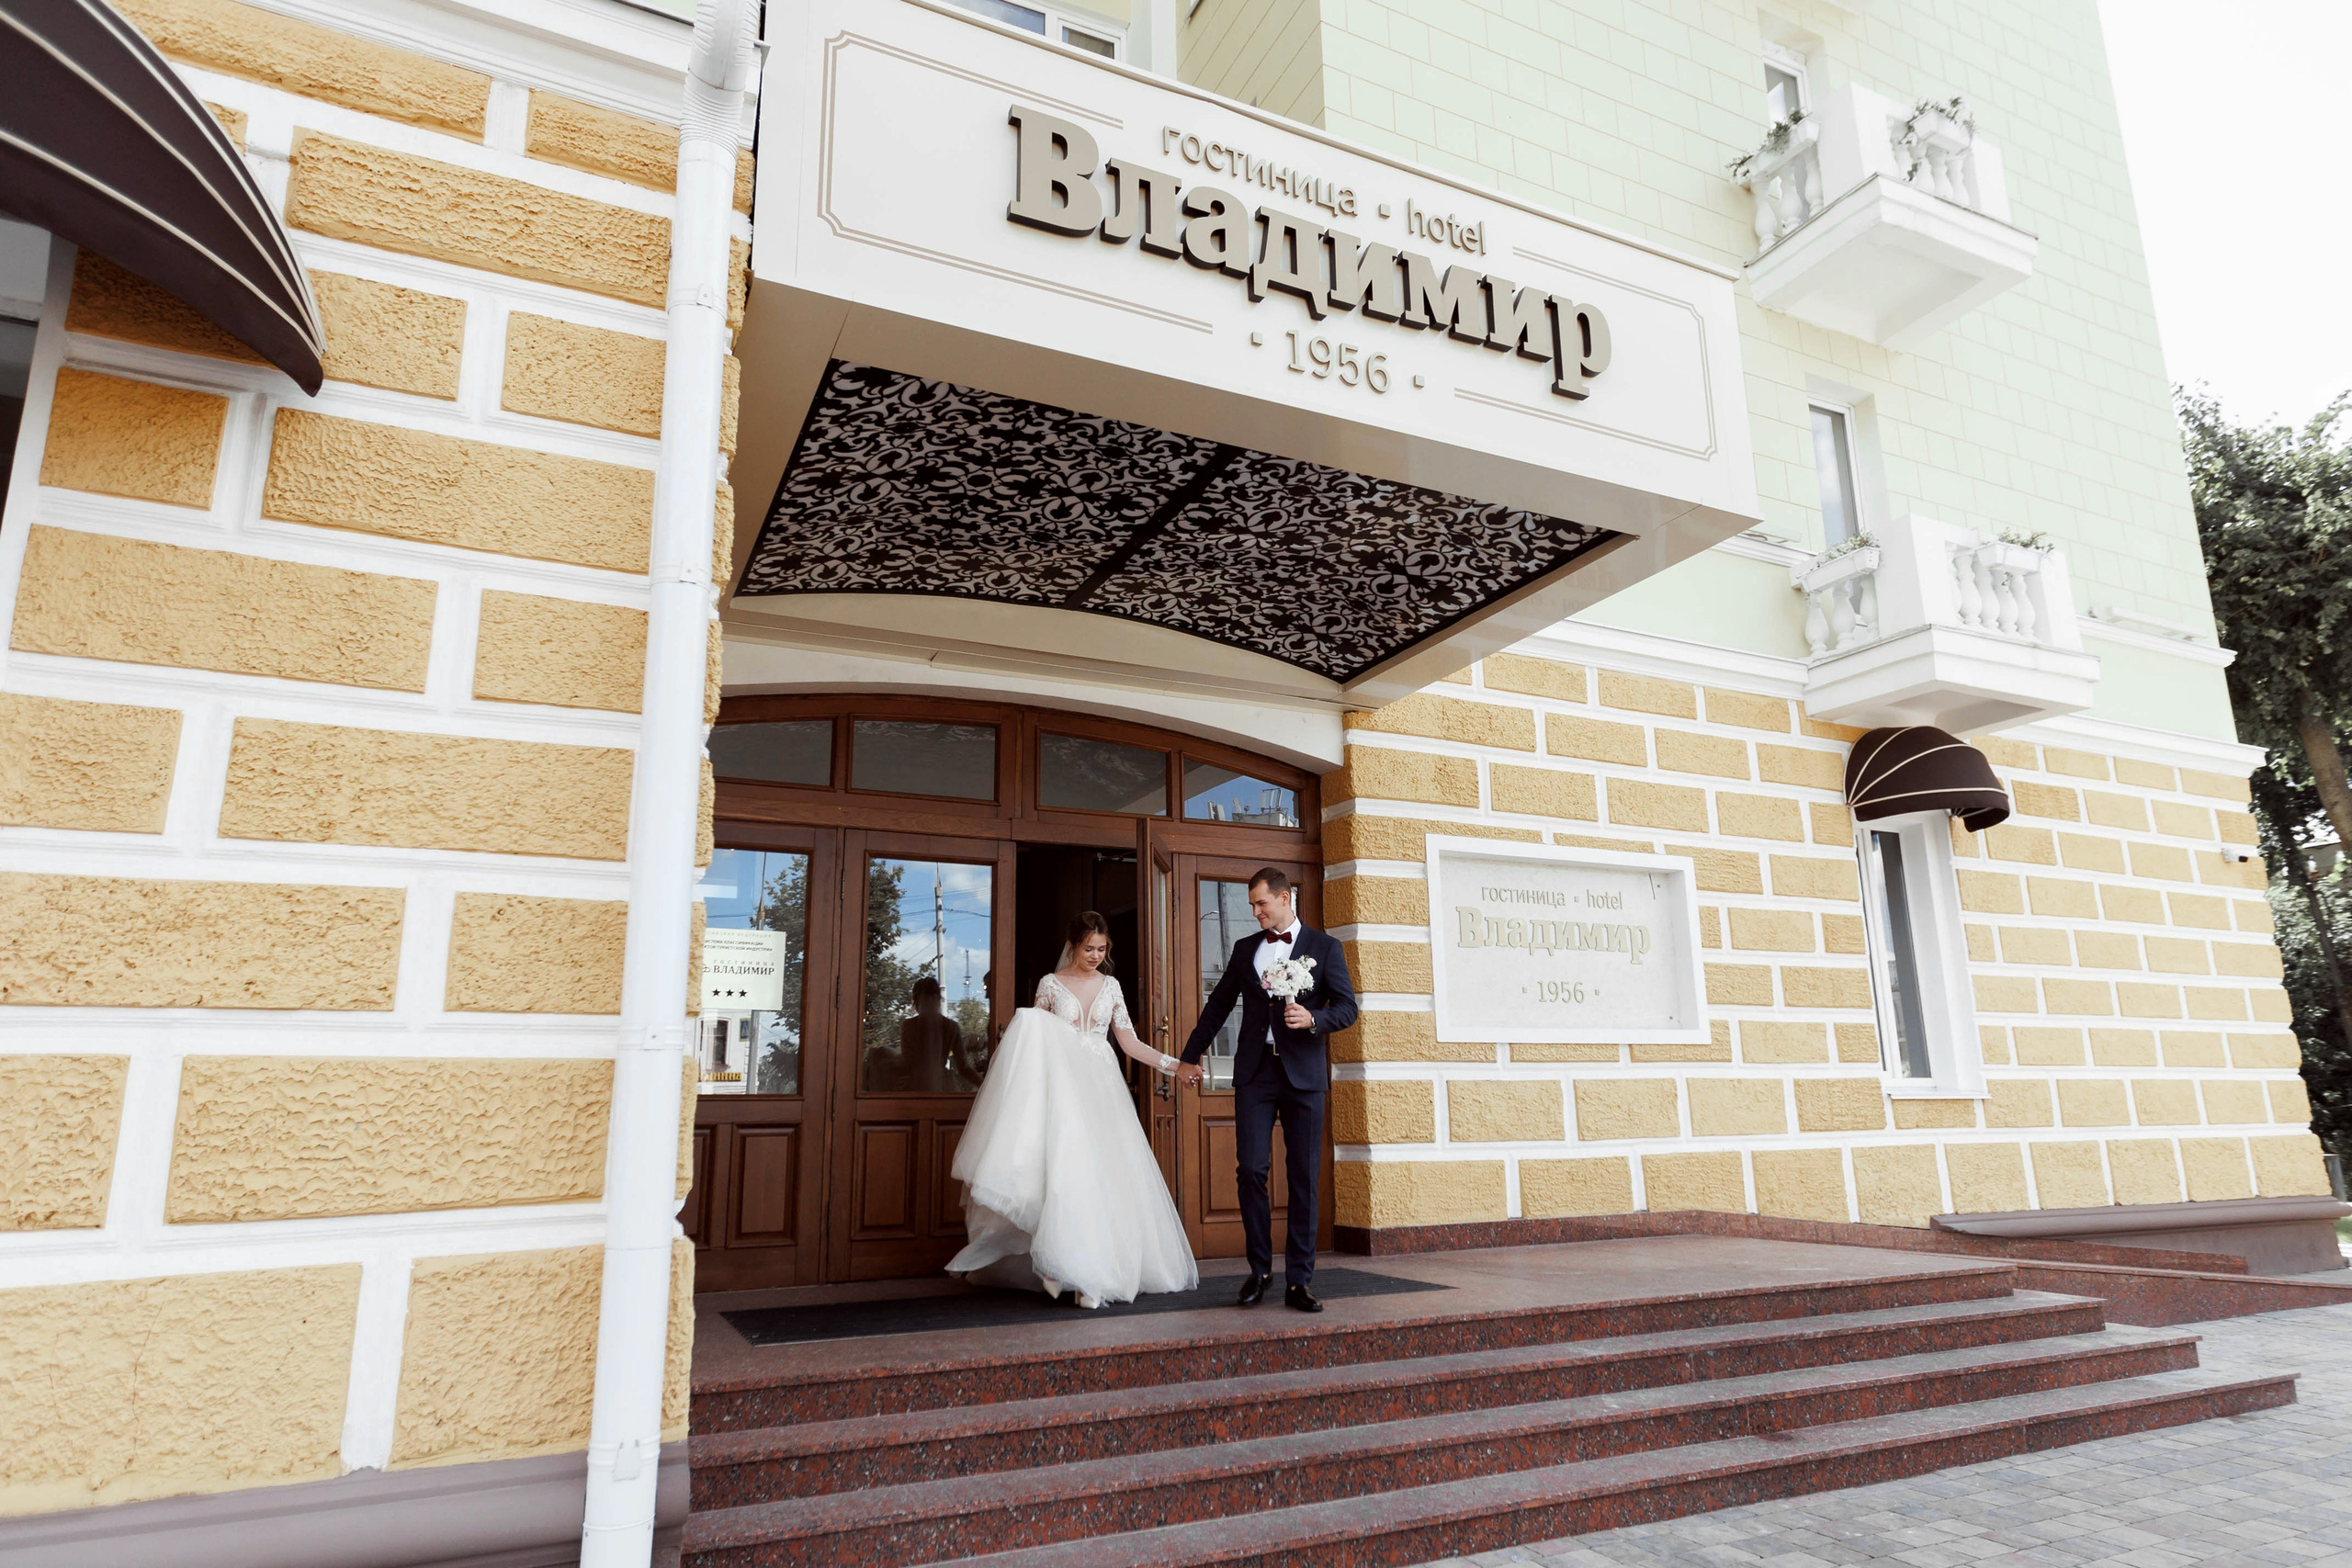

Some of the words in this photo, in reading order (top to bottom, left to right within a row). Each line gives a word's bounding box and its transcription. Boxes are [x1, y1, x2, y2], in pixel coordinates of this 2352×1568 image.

[1162, 125, 1358, 218] гостиница
[1405, 197, 1487, 255] hotel
[1006, 104, 1612, 401] Владимир
[1285, 329, 1390, 393] 1956
[1481, 886, 1566, 908] гостиница
[1587, 889, 1623, 910] hotel
[1456, 906, 1651, 964] Владимир
[713, 964, 775, 976] ВЛАДИМИР
[1536, 979, 1586, 1004] 1956
